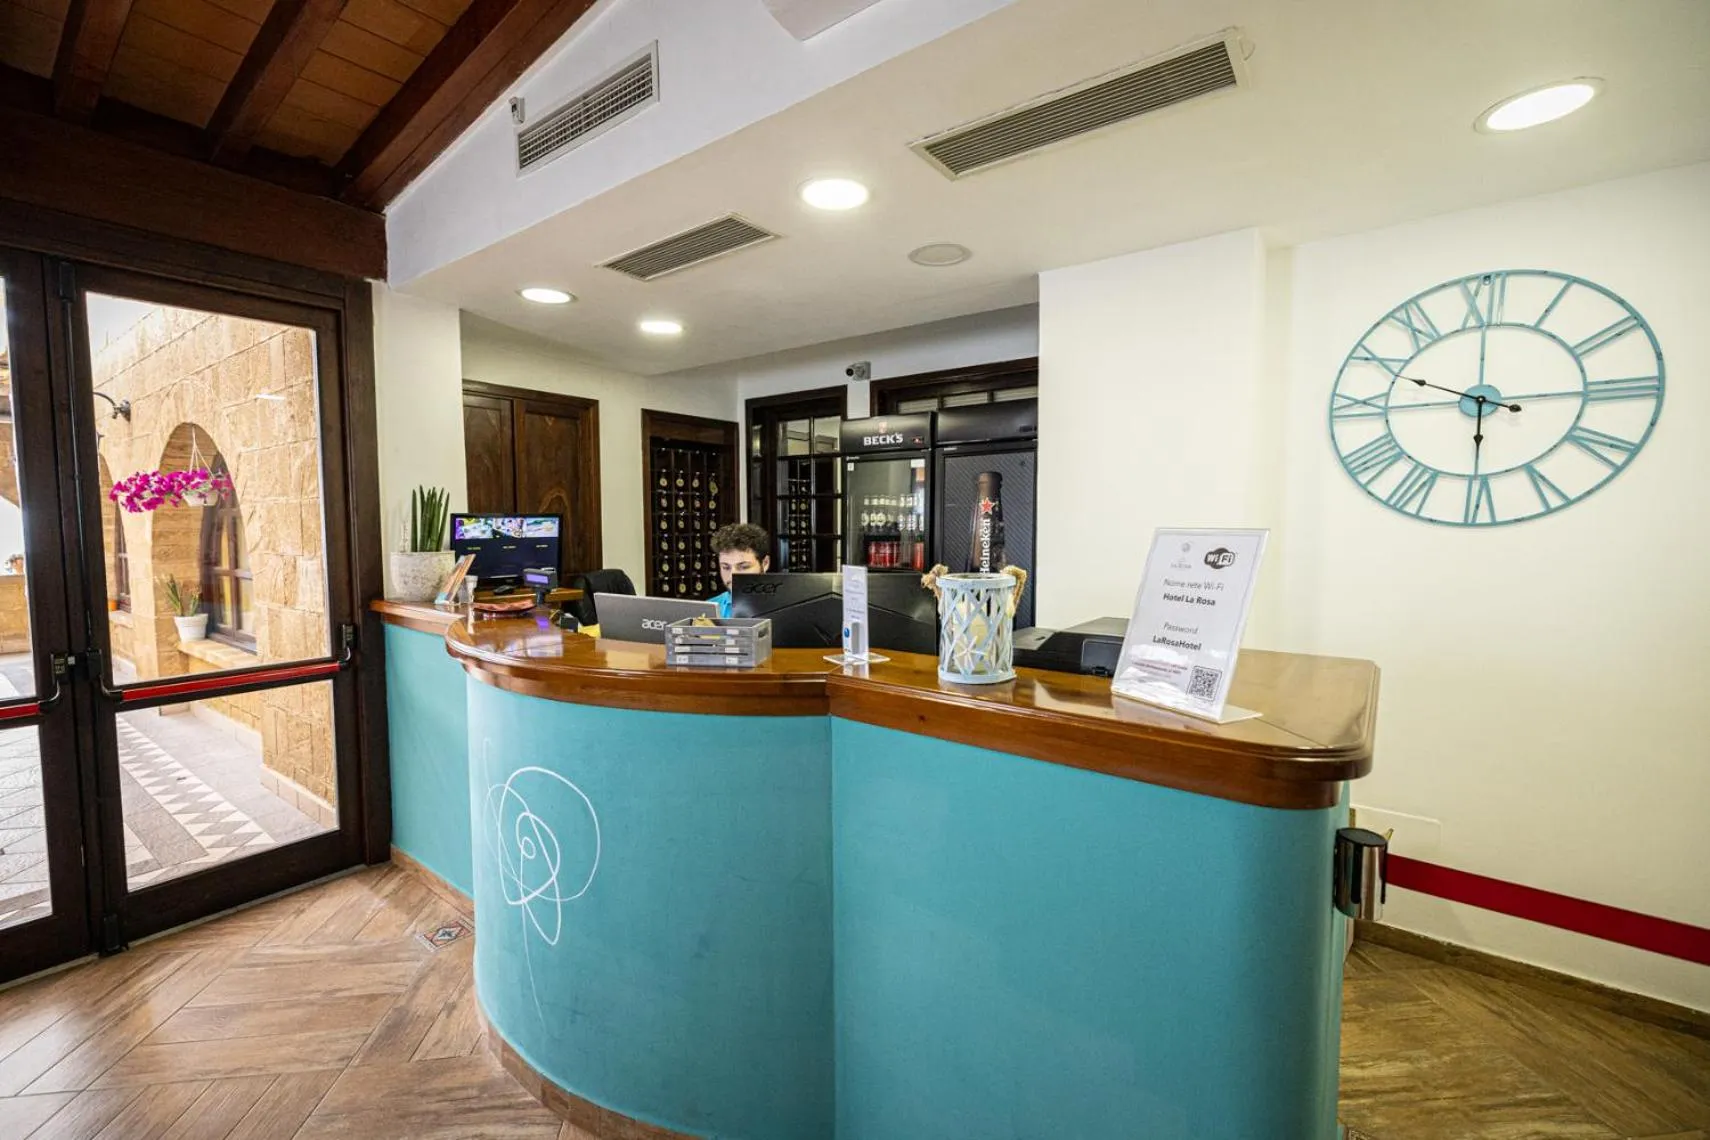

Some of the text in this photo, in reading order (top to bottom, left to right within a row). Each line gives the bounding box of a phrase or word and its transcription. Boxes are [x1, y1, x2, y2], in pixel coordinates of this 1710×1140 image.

[864, 433, 904, 446] BECK'S
[980, 518, 991, 574] Heineken
[742, 582, 784, 596] acer
[1163, 578, 1225, 591] Nome rete Wi-Fi
[1163, 592, 1216, 606] Hotel La Rosa
[641, 618, 667, 631] acer
[1163, 622, 1199, 635] Password
[1152, 635, 1202, 651] LaRosaHotel
